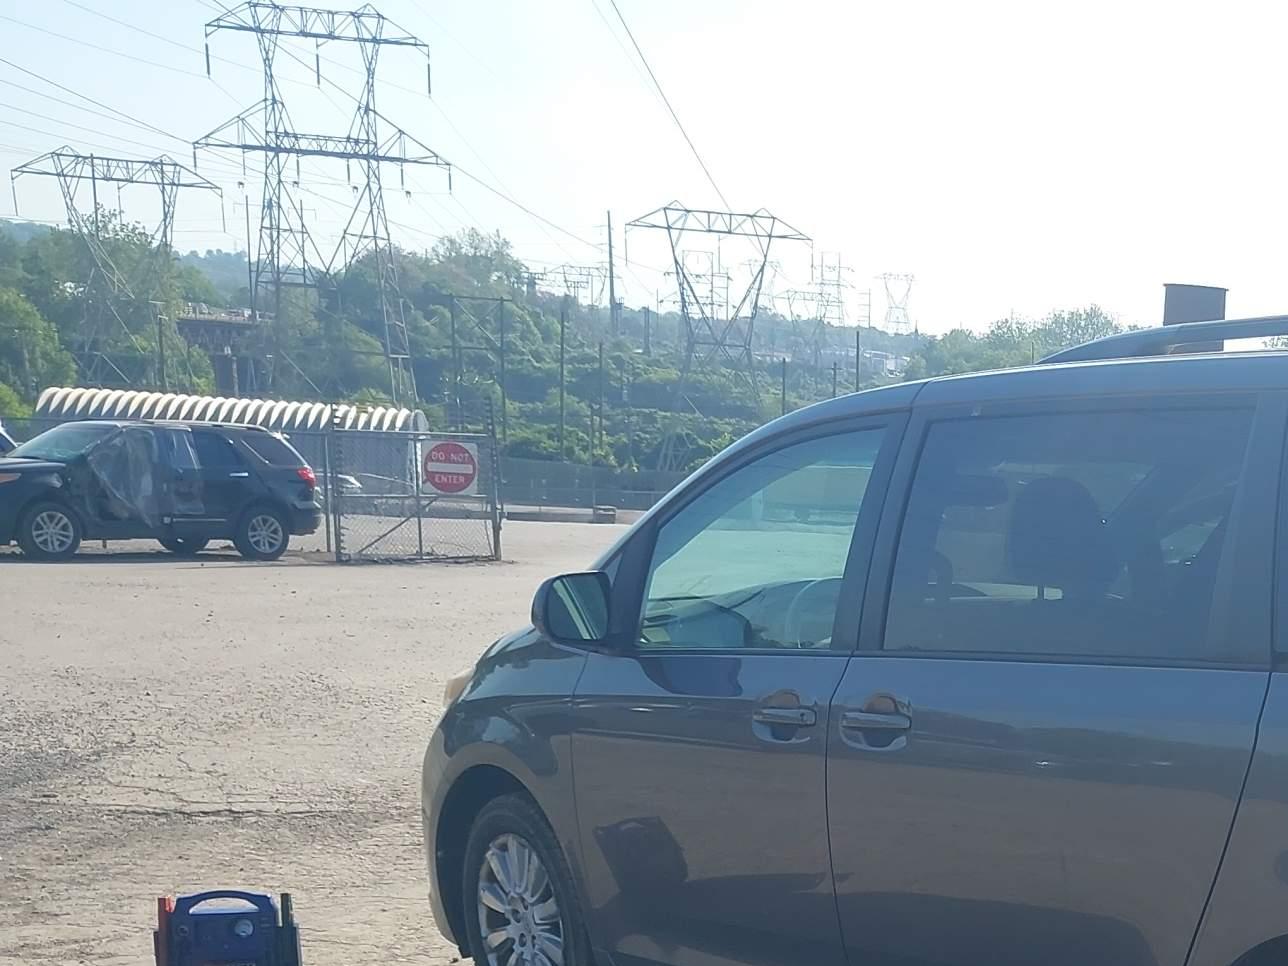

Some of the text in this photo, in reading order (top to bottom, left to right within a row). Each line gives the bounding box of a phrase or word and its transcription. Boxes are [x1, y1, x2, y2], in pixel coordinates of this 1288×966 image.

[431, 451, 470, 461] DO NOT
[435, 475, 465, 483] ENTER
